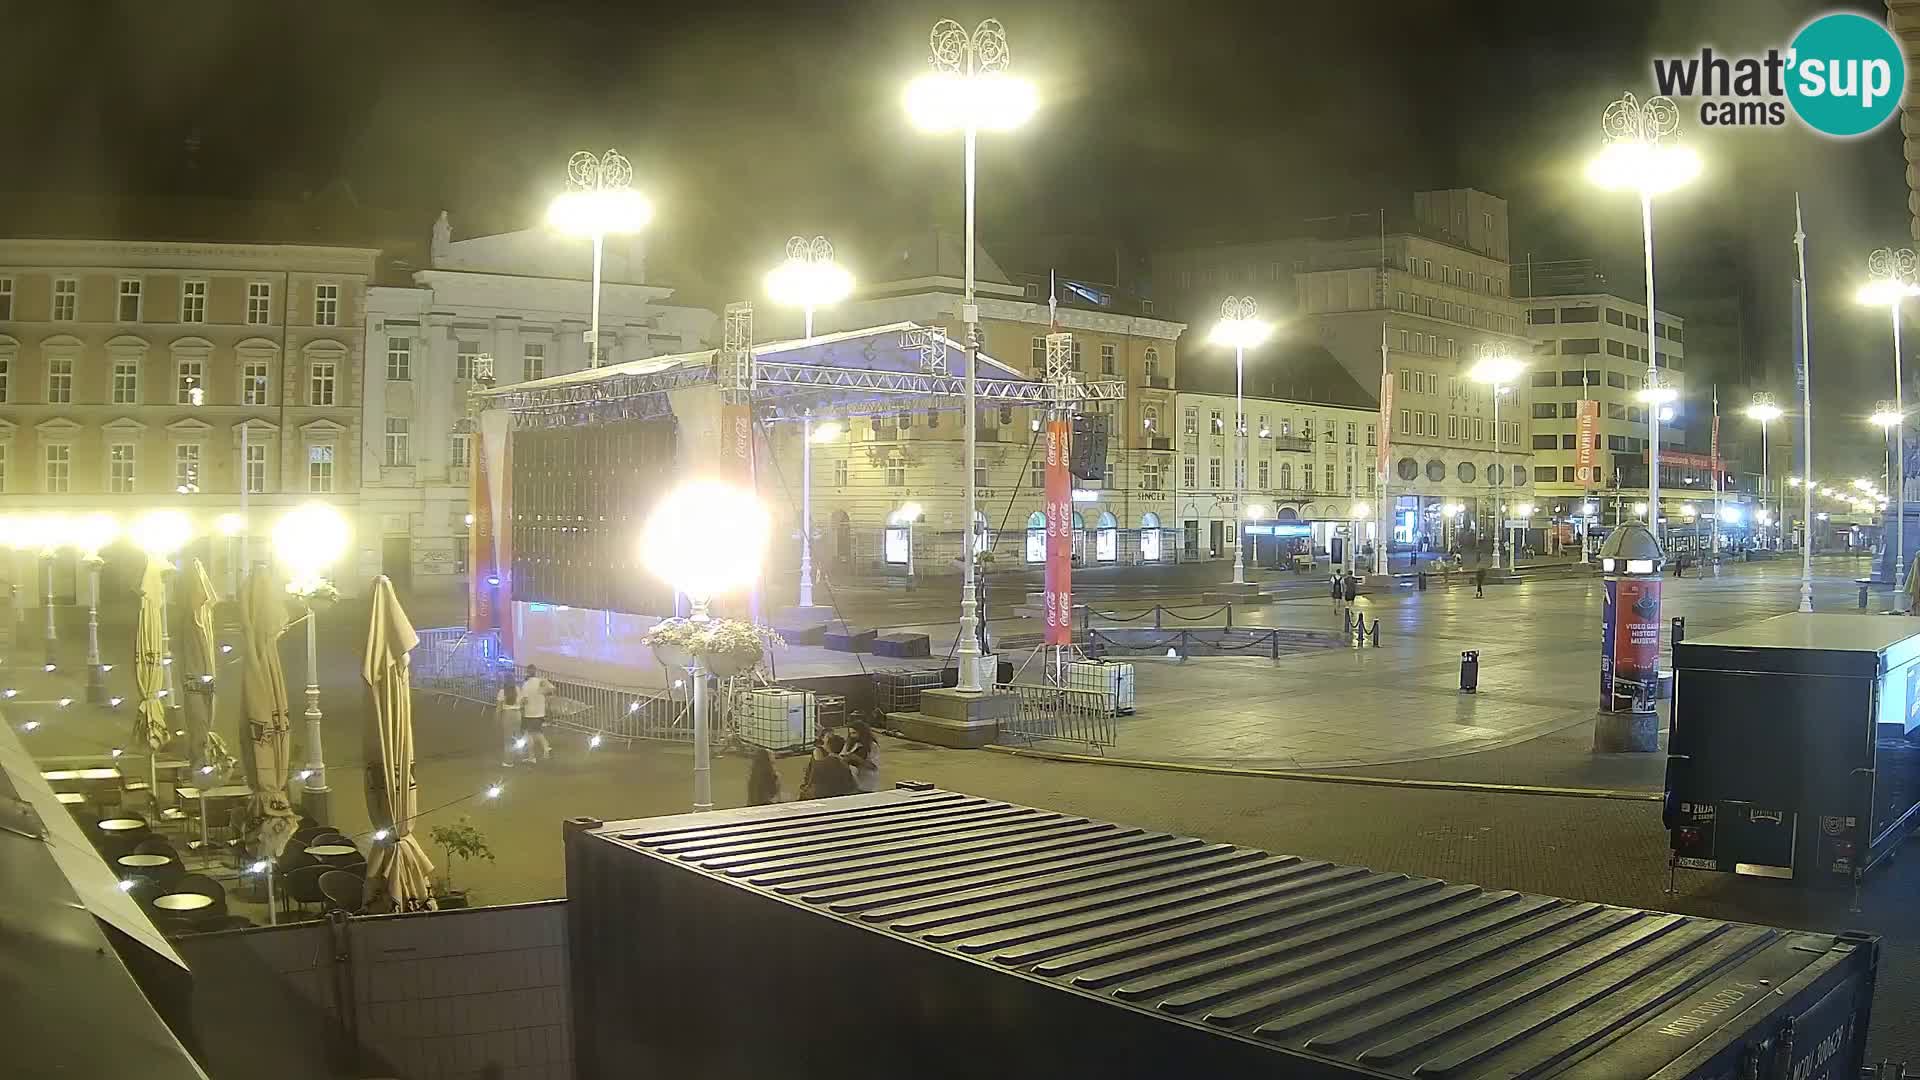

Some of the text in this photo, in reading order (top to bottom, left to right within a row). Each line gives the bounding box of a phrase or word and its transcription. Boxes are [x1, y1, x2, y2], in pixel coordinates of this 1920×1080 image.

[1137, 492, 1166, 501] SINGER
[1047, 501, 1056, 537] Coca-Cola
[1060, 501, 1069, 537] Coca-Cola
[1047, 591, 1056, 627] Coca-Cola
[1060, 591, 1069, 627] Coca-Cola
[1690, 989, 1745, 1017] 300629
